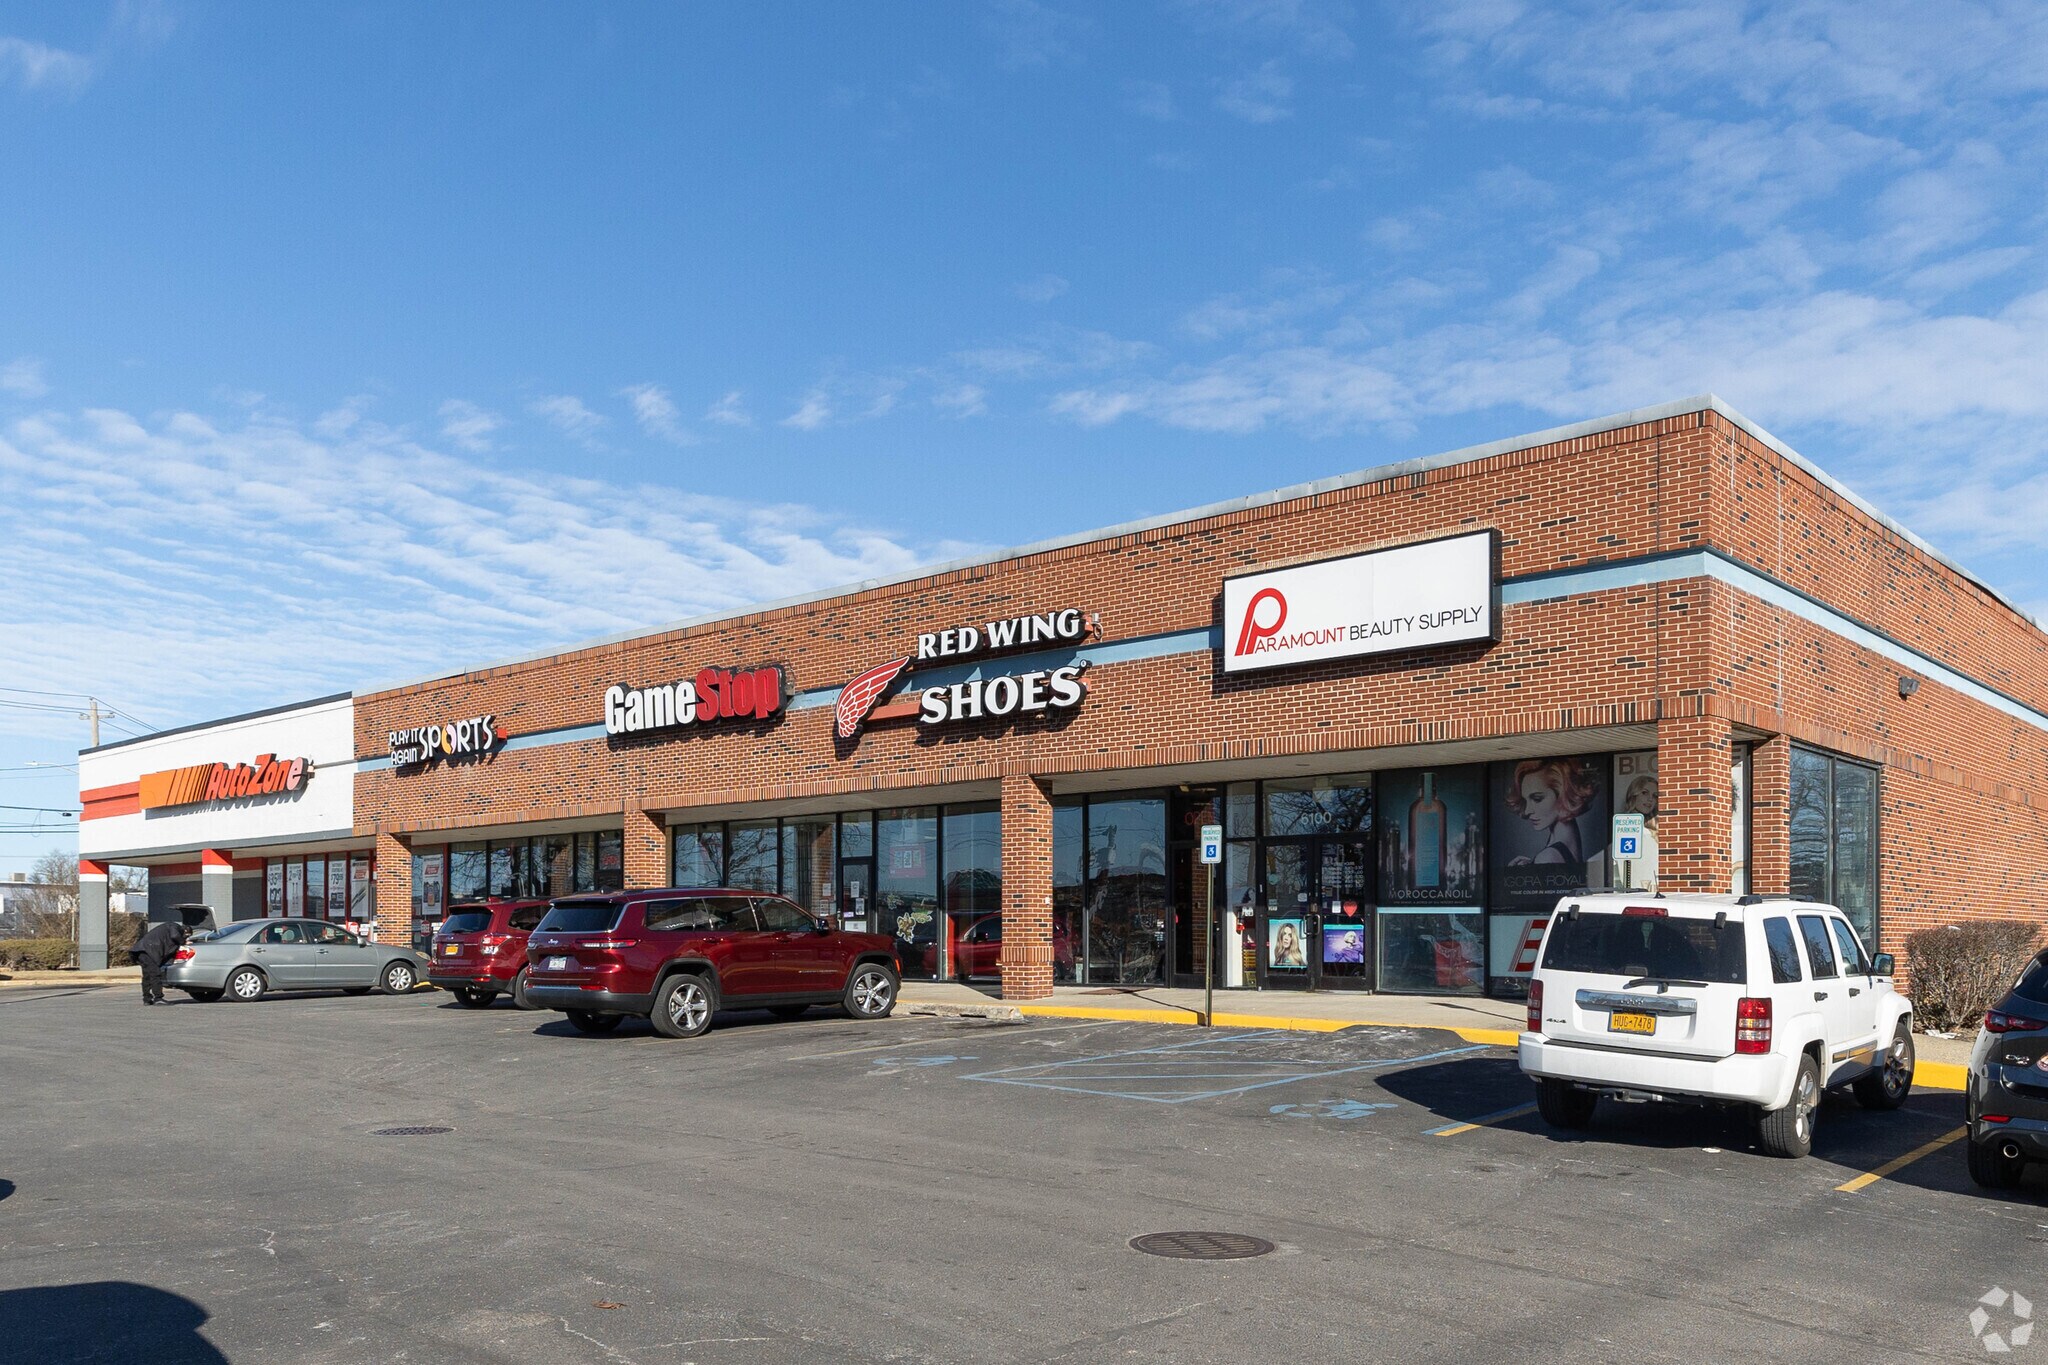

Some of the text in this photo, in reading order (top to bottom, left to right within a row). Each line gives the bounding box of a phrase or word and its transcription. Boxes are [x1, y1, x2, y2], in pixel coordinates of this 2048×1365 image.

[917, 608, 1081, 660] RED WING
[1234, 587, 1482, 656] PARAMOUNT BEAUTY SUPPLY
[604, 667, 780, 735] GameStop
[920, 666, 1082, 724] SHOES
[389, 728, 419, 746] PLAY IT
[391, 748, 417, 765] AGAIN
[419, 714, 493, 760] SPORTS
[205, 753, 304, 801] AutoZone
[1301, 811, 1332, 825] 6100
[1546, 874, 1586, 886] ROYAL
